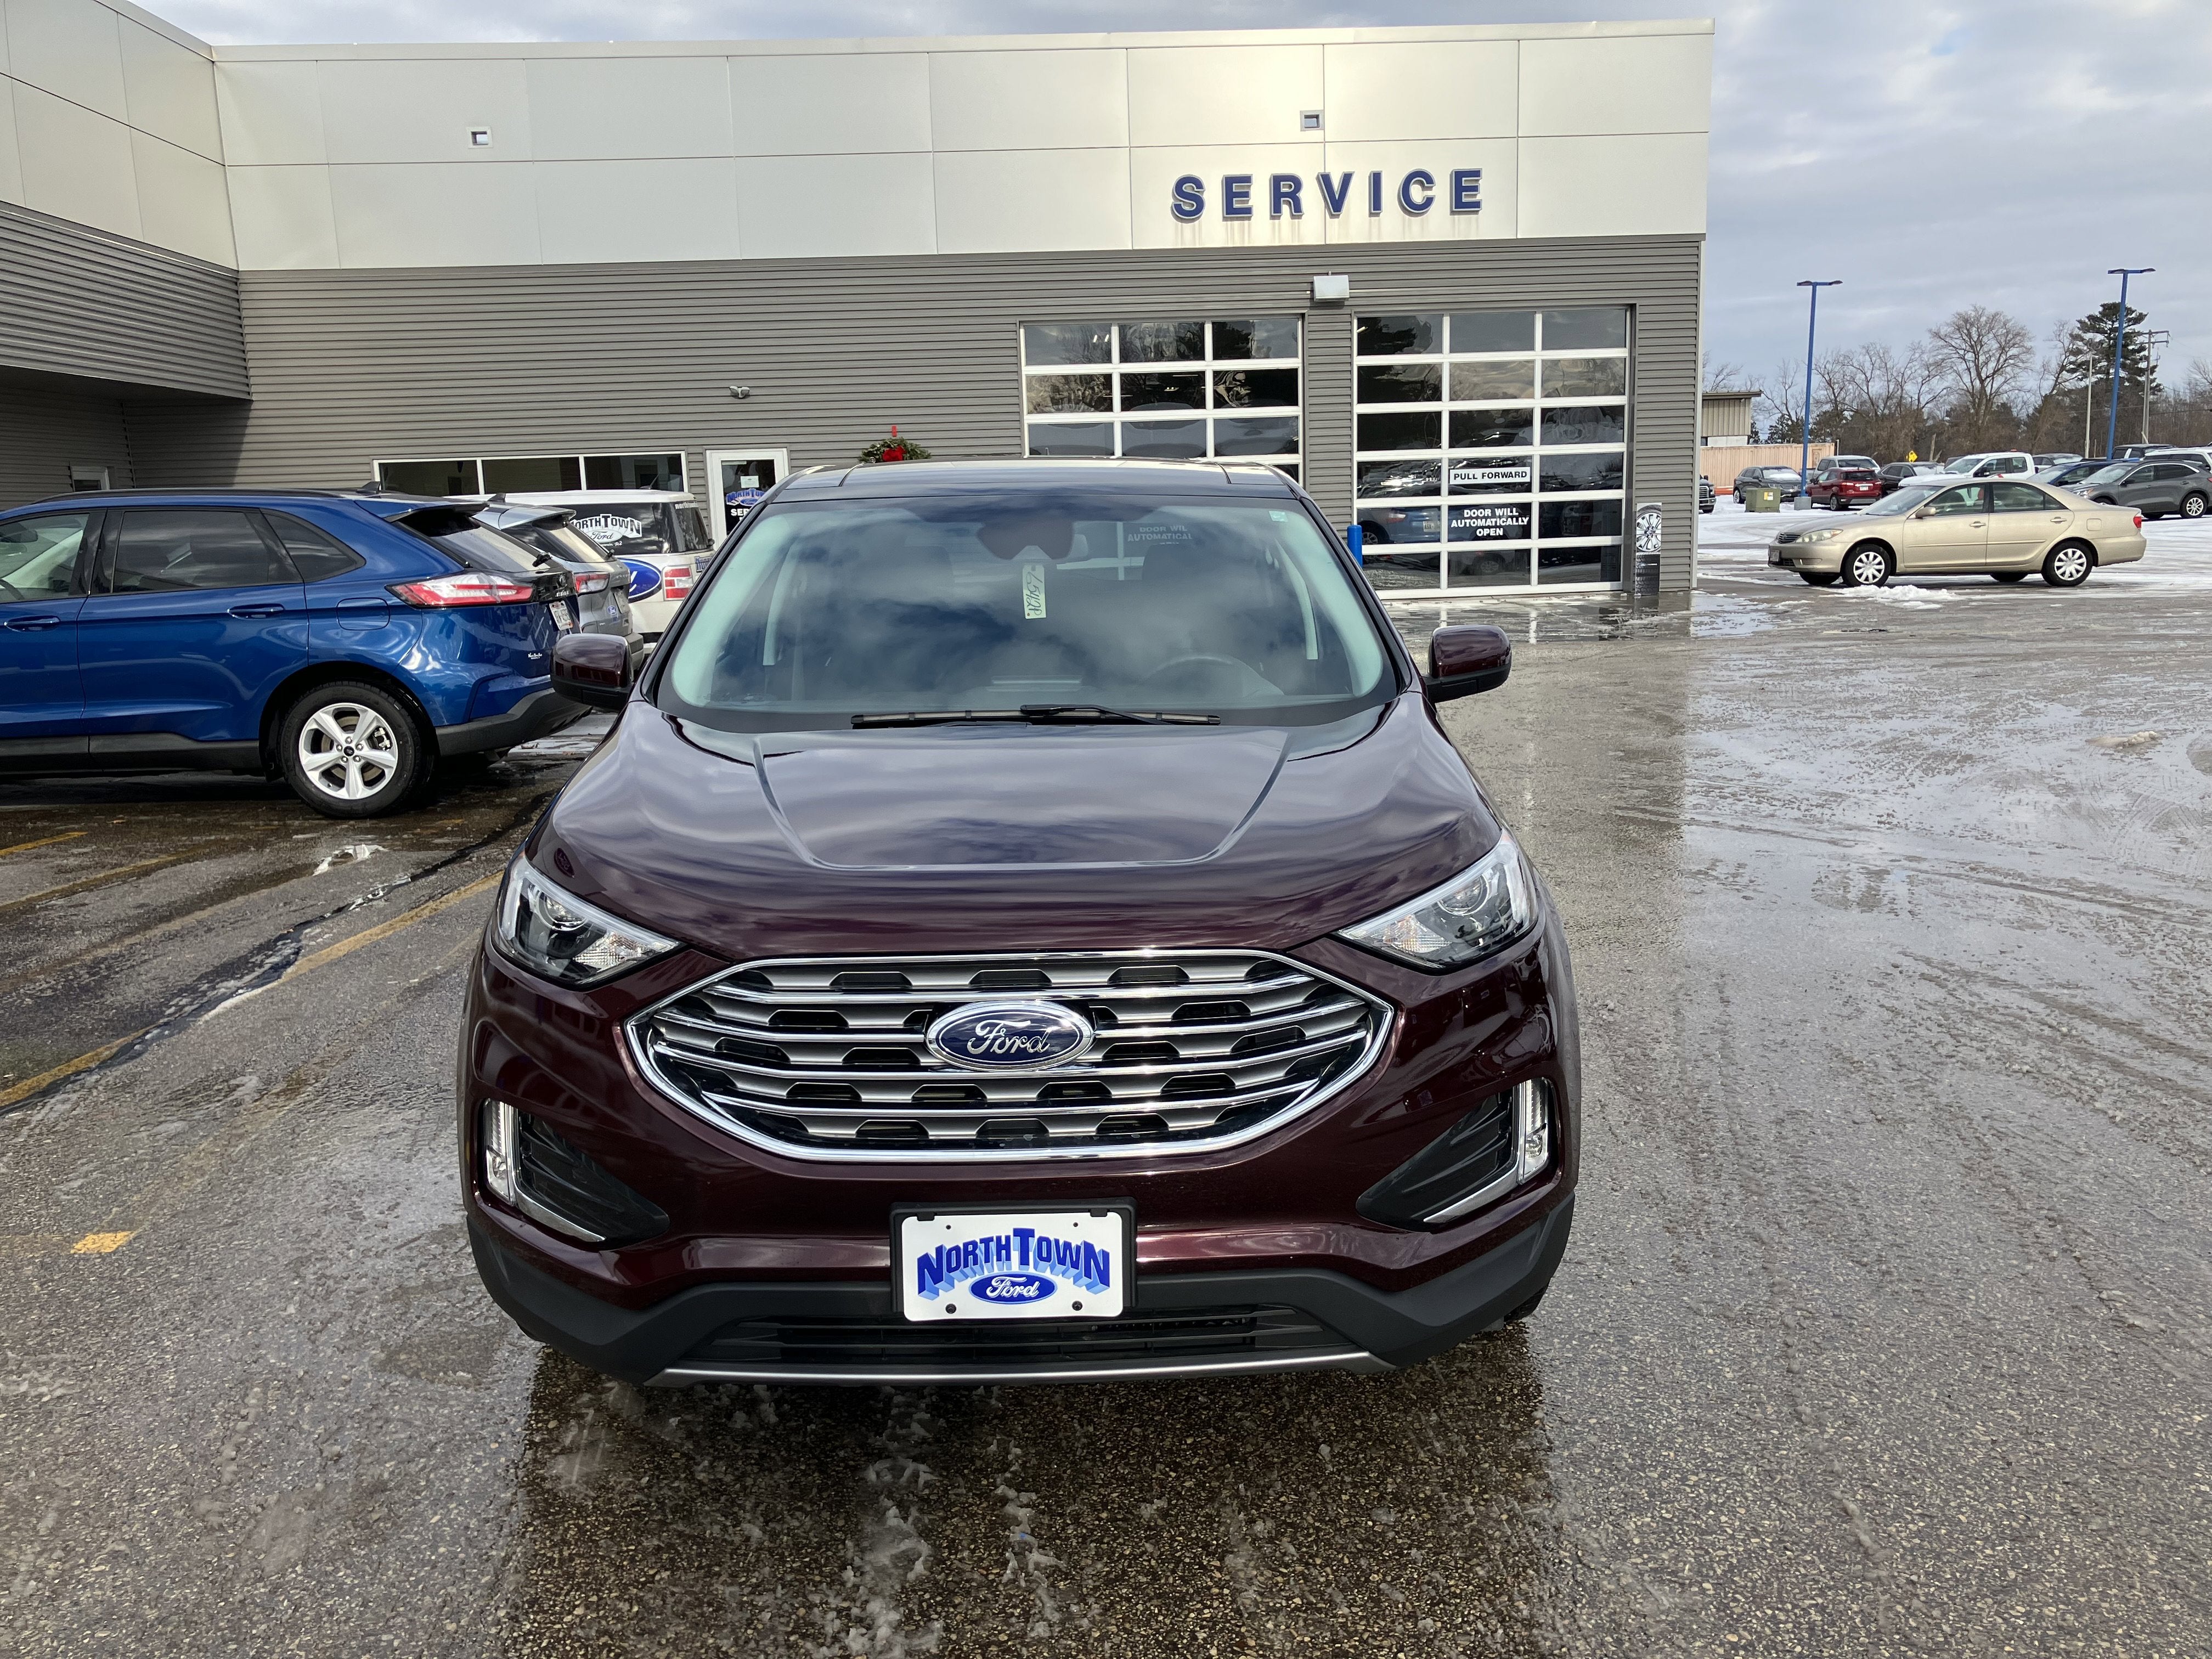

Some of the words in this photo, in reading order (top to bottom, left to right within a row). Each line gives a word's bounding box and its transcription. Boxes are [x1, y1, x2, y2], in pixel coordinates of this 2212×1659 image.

[1171, 168, 1482, 221] SERVICE
[1464, 509, 1492, 517] DOOR
[1495, 507, 1519, 516] WILL
[1451, 517, 1530, 527] AUTOMATICALLY
[591, 531, 614, 540] Ford
[1127, 533, 1192, 542] AUTOMATICAL
[1476, 528, 1503, 537] OPEN
[967, 1019, 1054, 1054] Ford
[986, 1276, 1040, 1298] Ford
